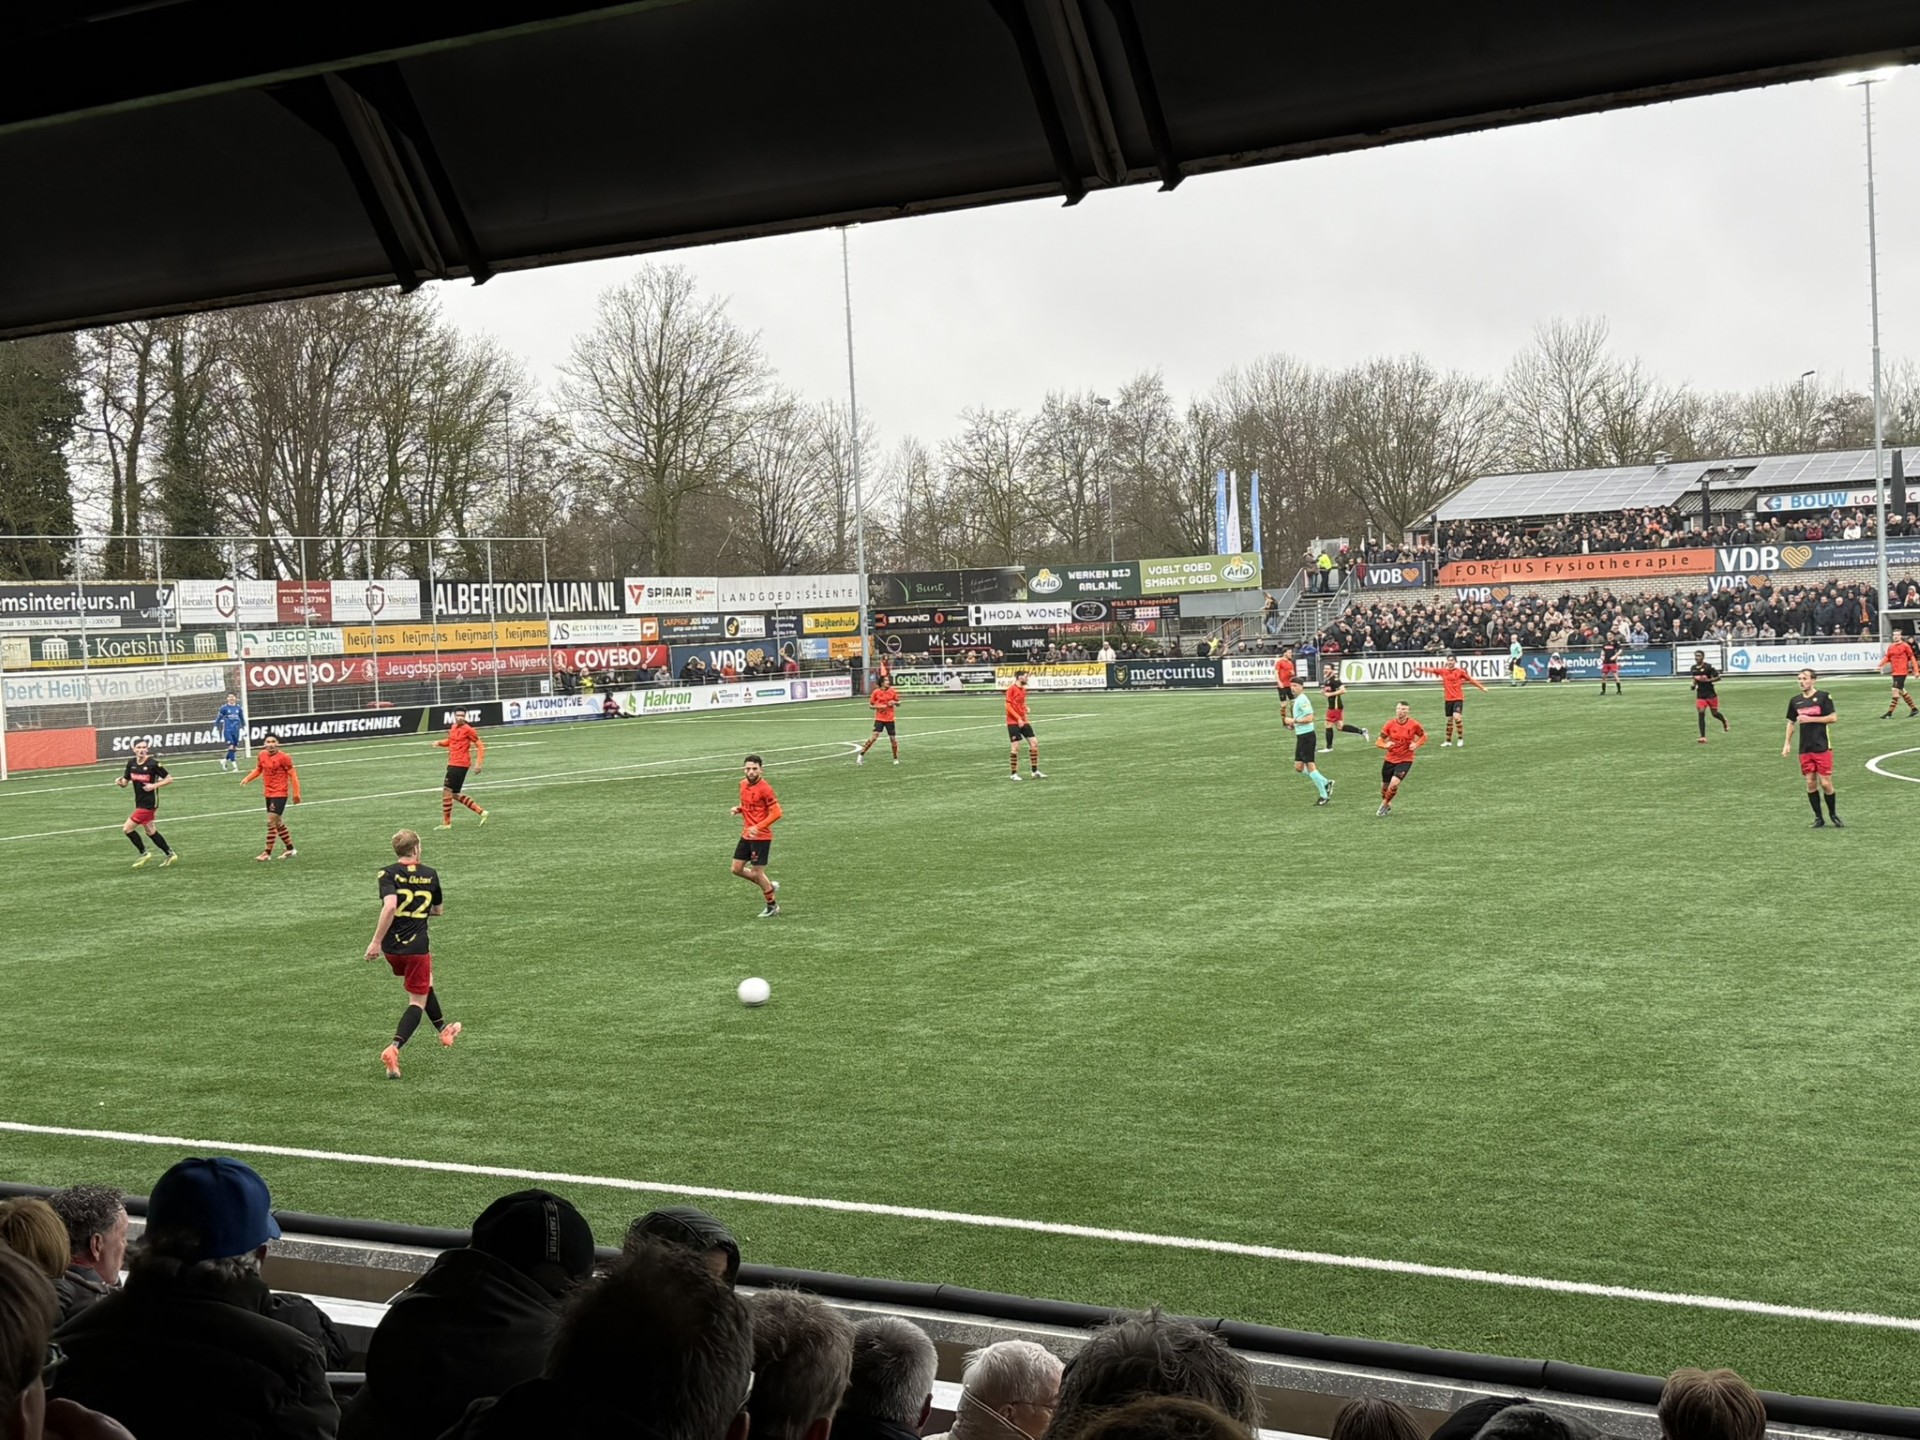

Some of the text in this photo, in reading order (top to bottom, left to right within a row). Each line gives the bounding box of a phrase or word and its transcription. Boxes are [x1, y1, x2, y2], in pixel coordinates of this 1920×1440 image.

[1790, 492, 1848, 509] BOUW
[1544, 554, 1689, 574] Fysiotherapie
[1718, 546, 1780, 572] VDB
[1068, 568, 1131, 579] WERKEN BIJ
[1148, 562, 1212, 575] VOELT GOED
[1227, 567, 1250, 577] Arla
[1034, 579, 1057, 588] Arla
[1145, 574, 1217, 588] SMAAKT GOED
[1368, 568, 1402, 585] VDB
[1709, 574, 1747, 591] VDB
[647, 587, 692, 598] SPIRAIR
[916, 583, 945, 593] Bunt
[1078, 582, 1122, 591] ARLA.NL
[0, 590, 136, 612] msinterieurs.nl
[300, 596, 327, 604] 257396
[435, 581, 620, 616] ALBERTOSITALIAN.NL
[721, 591, 792, 602] LANDGOED
[1457, 587, 1491, 602] VDB
[888, 613, 930, 624] STANNO
[988, 611, 1022, 620] HODA
[1026, 608, 1072, 618] WONEN
[814, 616, 856, 629] Buijtenhuis
[266, 631, 337, 643] JECOR.NL
[347, 632, 395, 648] heijmans
[402, 630, 448, 646] heijmans
[455, 628, 499, 642] heijmans
[505, 626, 548, 641] heijmans
[952, 632, 992, 646] SUSHI
[95, 634, 186, 658] Koetshuis
[267, 642, 337, 656] PROFESSONEEL
[575, 647, 642, 668] COVEBO
[710, 650, 747, 672] VDB
[1755, 653, 1787, 663] Albert
[1788, 652, 1815, 664] Heijn
[1817, 652, 1839, 662] Van
[1842, 651, 1860, 661] den
[385, 653, 548, 678] Jeugdsponsor Sparta Nijkerk
[1052, 667, 1082, 677] bouw
[1087, 665, 1102, 676] bv
[1130, 663, 1216, 680] mercurius
[1368, 660, 1500, 679] VAN DUINRKEN
[249, 662, 335, 687] COVEBO
[891, 671, 951, 685] Tegelstudio
[5, 669, 219, 701] bert Heijn Van den Tweel
[525, 696, 583, 710] AUTOMOTIVE
[643, 690, 692, 707] Hakron
[165, 731, 192, 747] EEN
[194, 730, 229, 745] BAA
[271, 715, 402, 738] INSTALLATIETECHNIEK
[394, 888, 433, 919] 22
